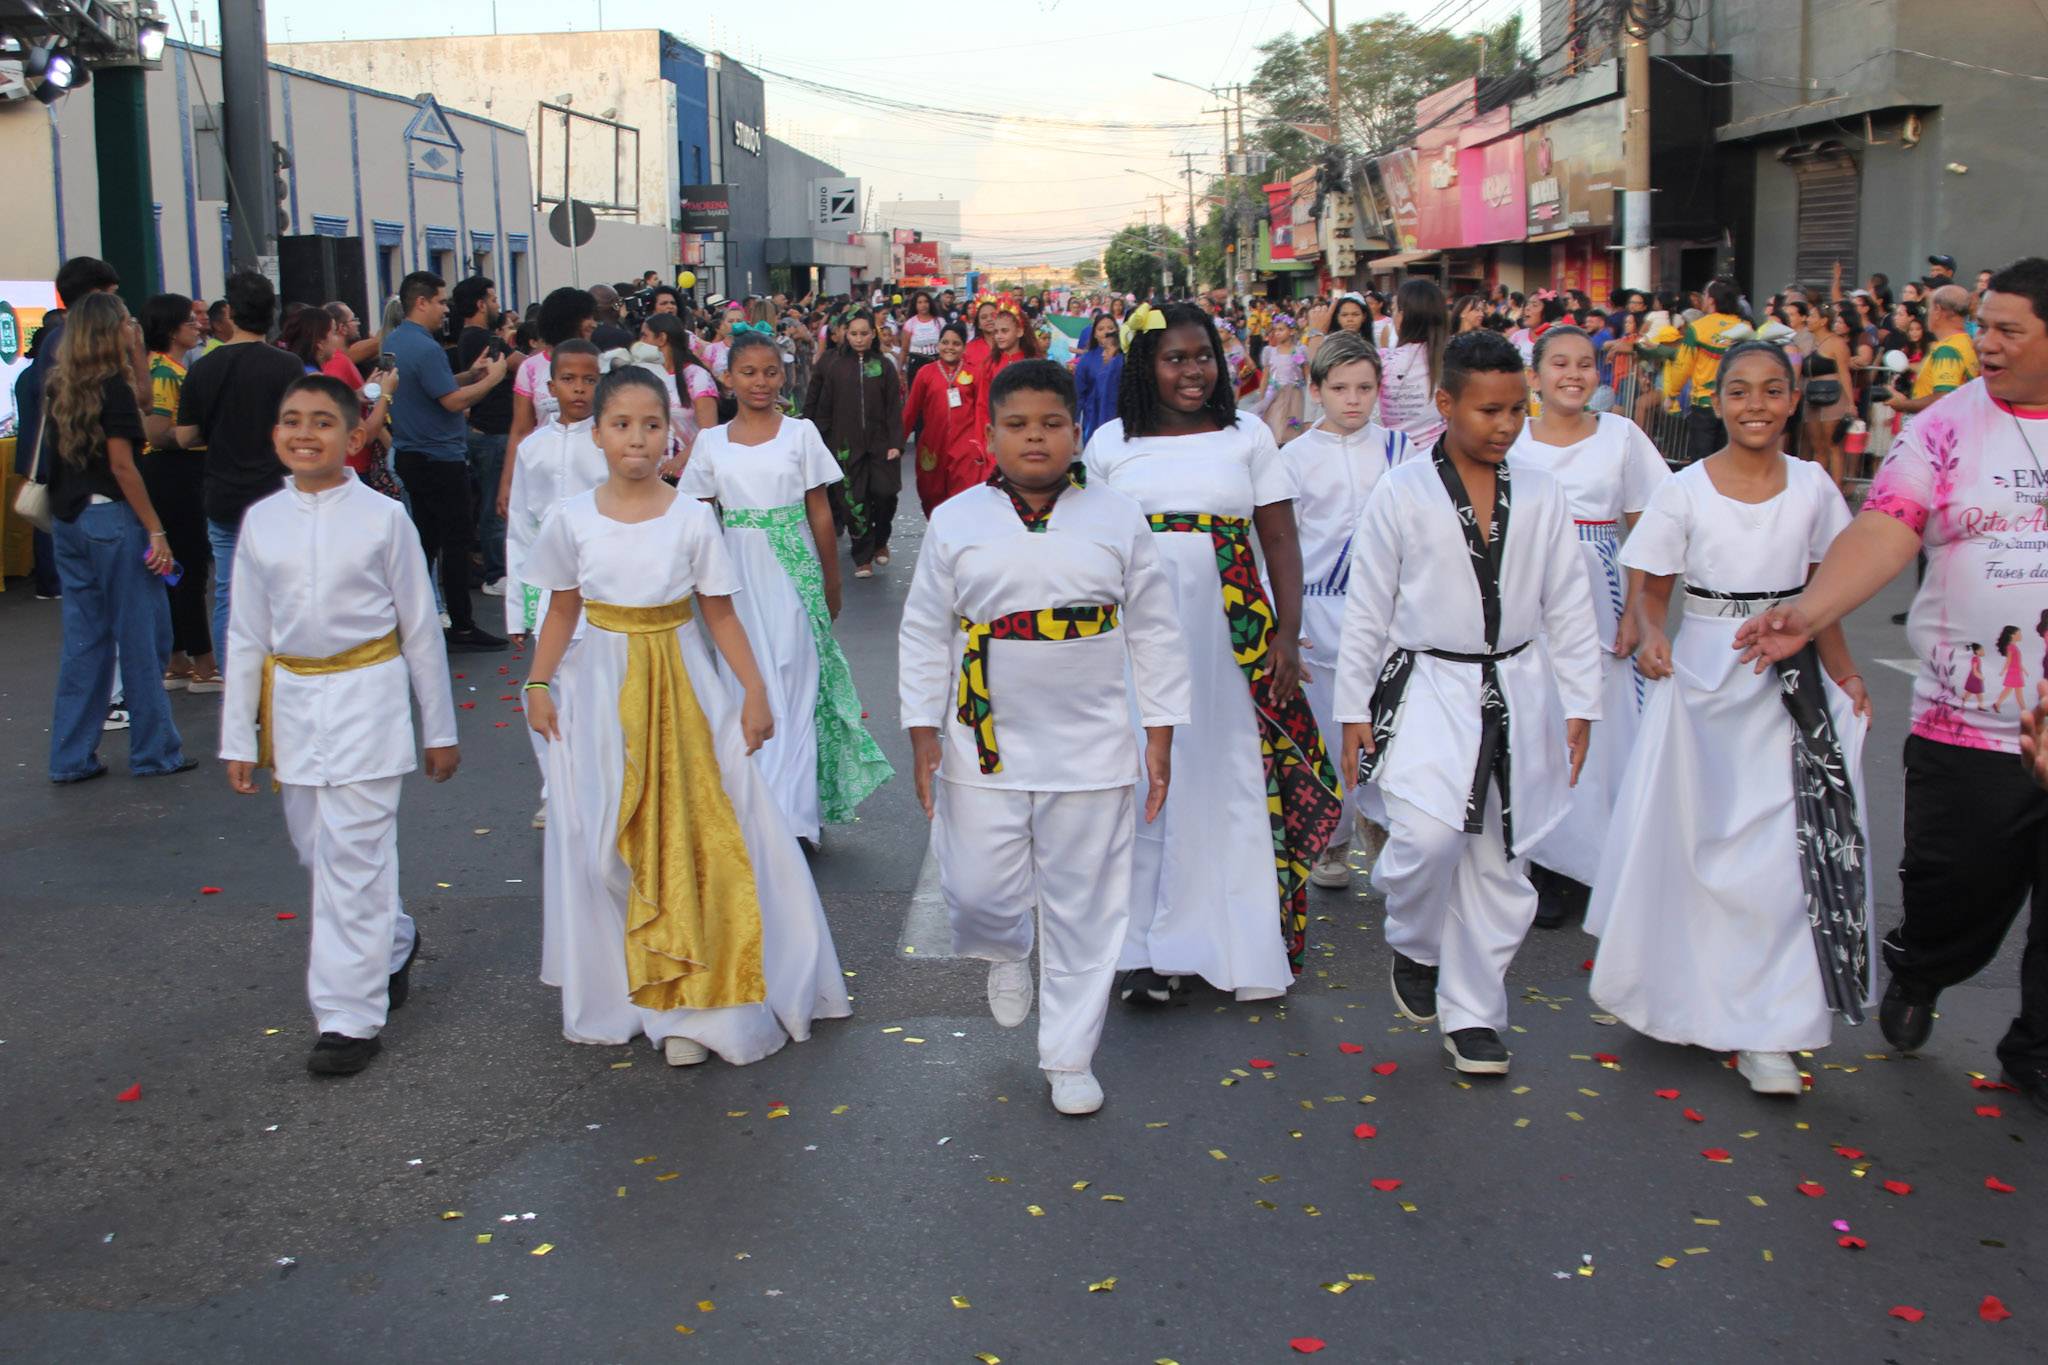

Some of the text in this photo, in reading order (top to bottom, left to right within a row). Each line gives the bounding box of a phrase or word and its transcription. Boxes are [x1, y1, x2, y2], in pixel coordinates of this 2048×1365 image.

[820, 186, 828, 223] STUDIO
[831, 188, 855, 222] Z
[1959, 506, 2008, 536] Rita
[1988, 538, 2003, 549] de
[1985, 561, 2048, 579] Fases da
